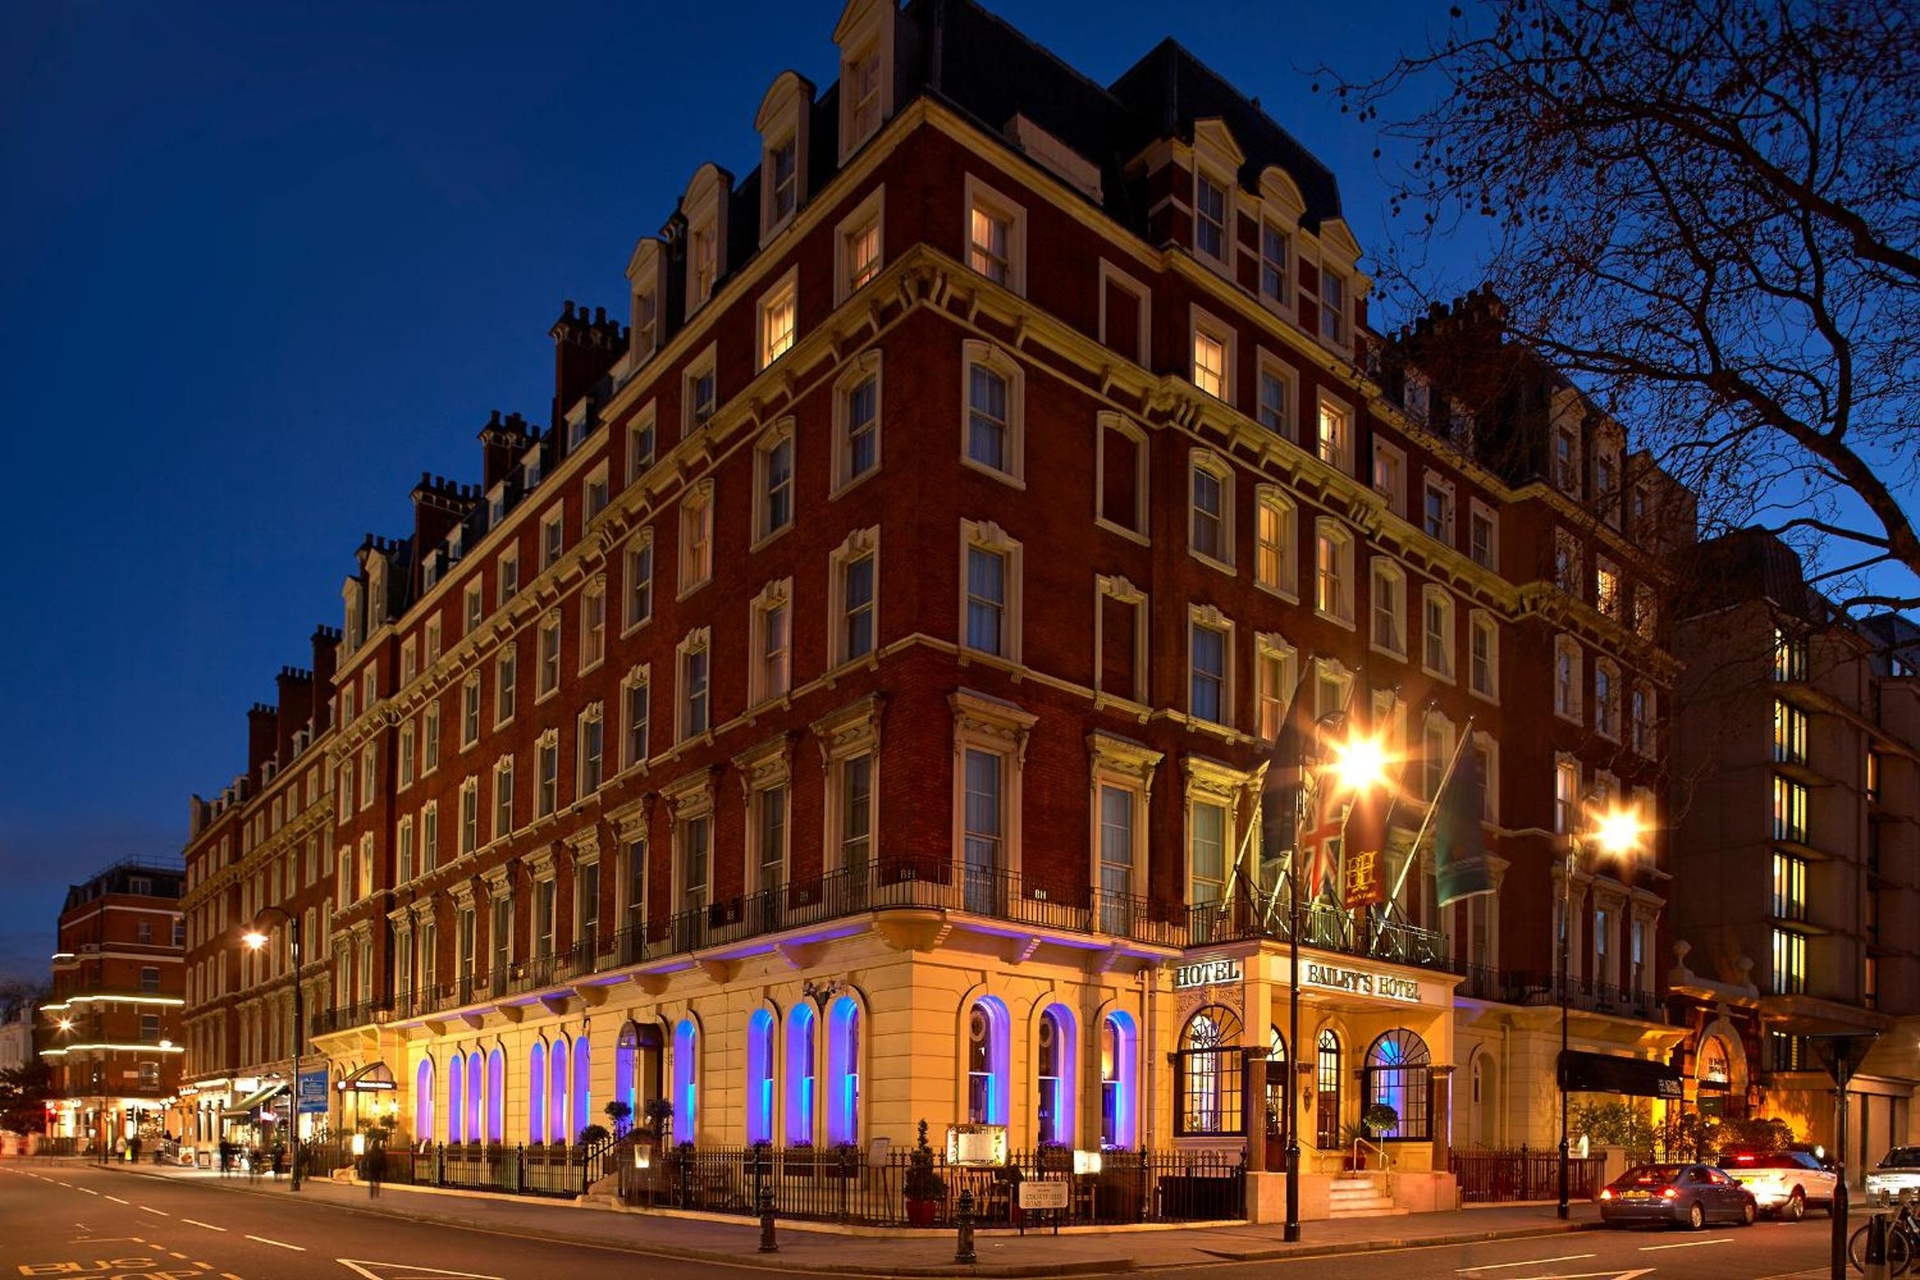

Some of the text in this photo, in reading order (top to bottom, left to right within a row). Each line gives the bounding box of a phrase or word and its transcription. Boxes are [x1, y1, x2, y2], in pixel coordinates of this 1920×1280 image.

[1175, 960, 1240, 986] HOTEL
[1307, 964, 1422, 1000] BAILEY'S HOTEL
[19, 1257, 158, 1275] BUS
